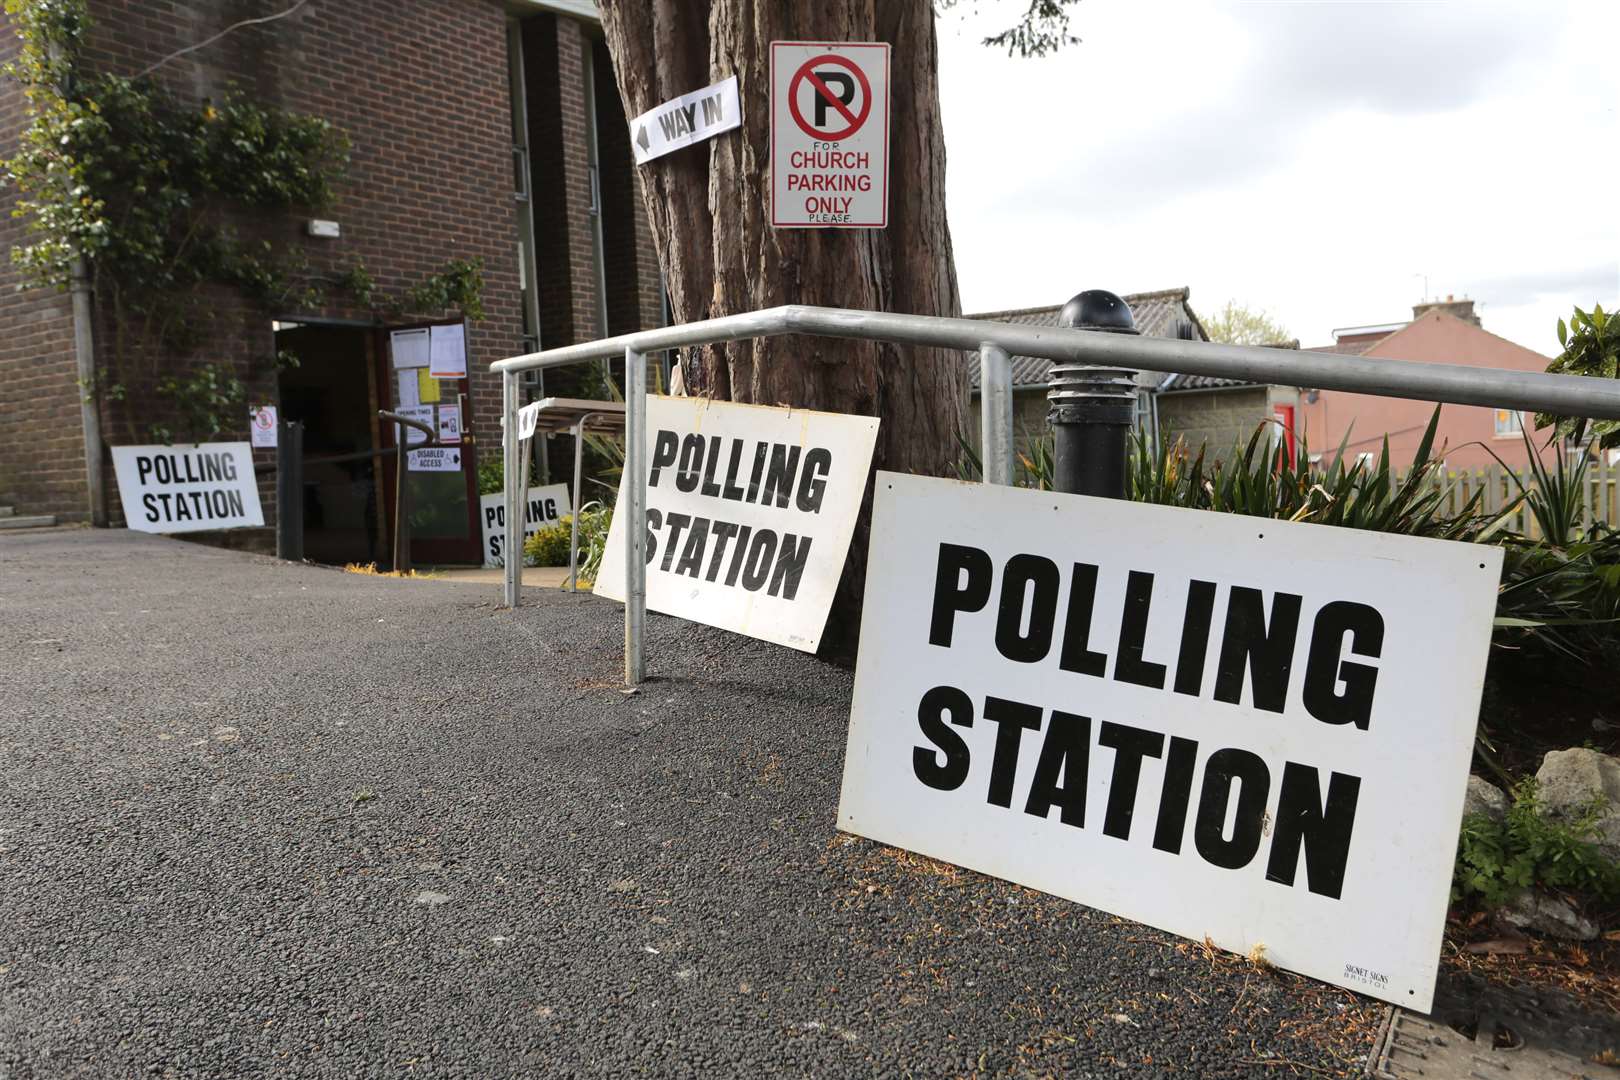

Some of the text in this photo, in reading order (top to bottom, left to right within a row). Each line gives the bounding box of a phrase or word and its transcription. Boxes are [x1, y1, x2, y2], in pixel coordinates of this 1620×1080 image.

[658, 92, 723, 142] WAY IN
[813, 141, 840, 151] FOR
[790, 151, 869, 169] CHURCH
[787, 174, 871, 192] PARKING
[805, 196, 853, 214] ONLY
[808, 213, 853, 223] PLEASE
[417, 449, 445, 458] DISABLED
[419, 459, 442, 468] ACCESS
[136, 452, 238, 486] POLLING
[648, 429, 832, 515] POLLING
[143, 489, 246, 523] STATION
[485, 498, 558, 529] POING
[644, 507, 813, 601] STATION
[928, 542, 1386, 731] POLLING
[912, 685, 1362, 900] STATION
[1345, 963, 1389, 985] SIGNET SIGNS
